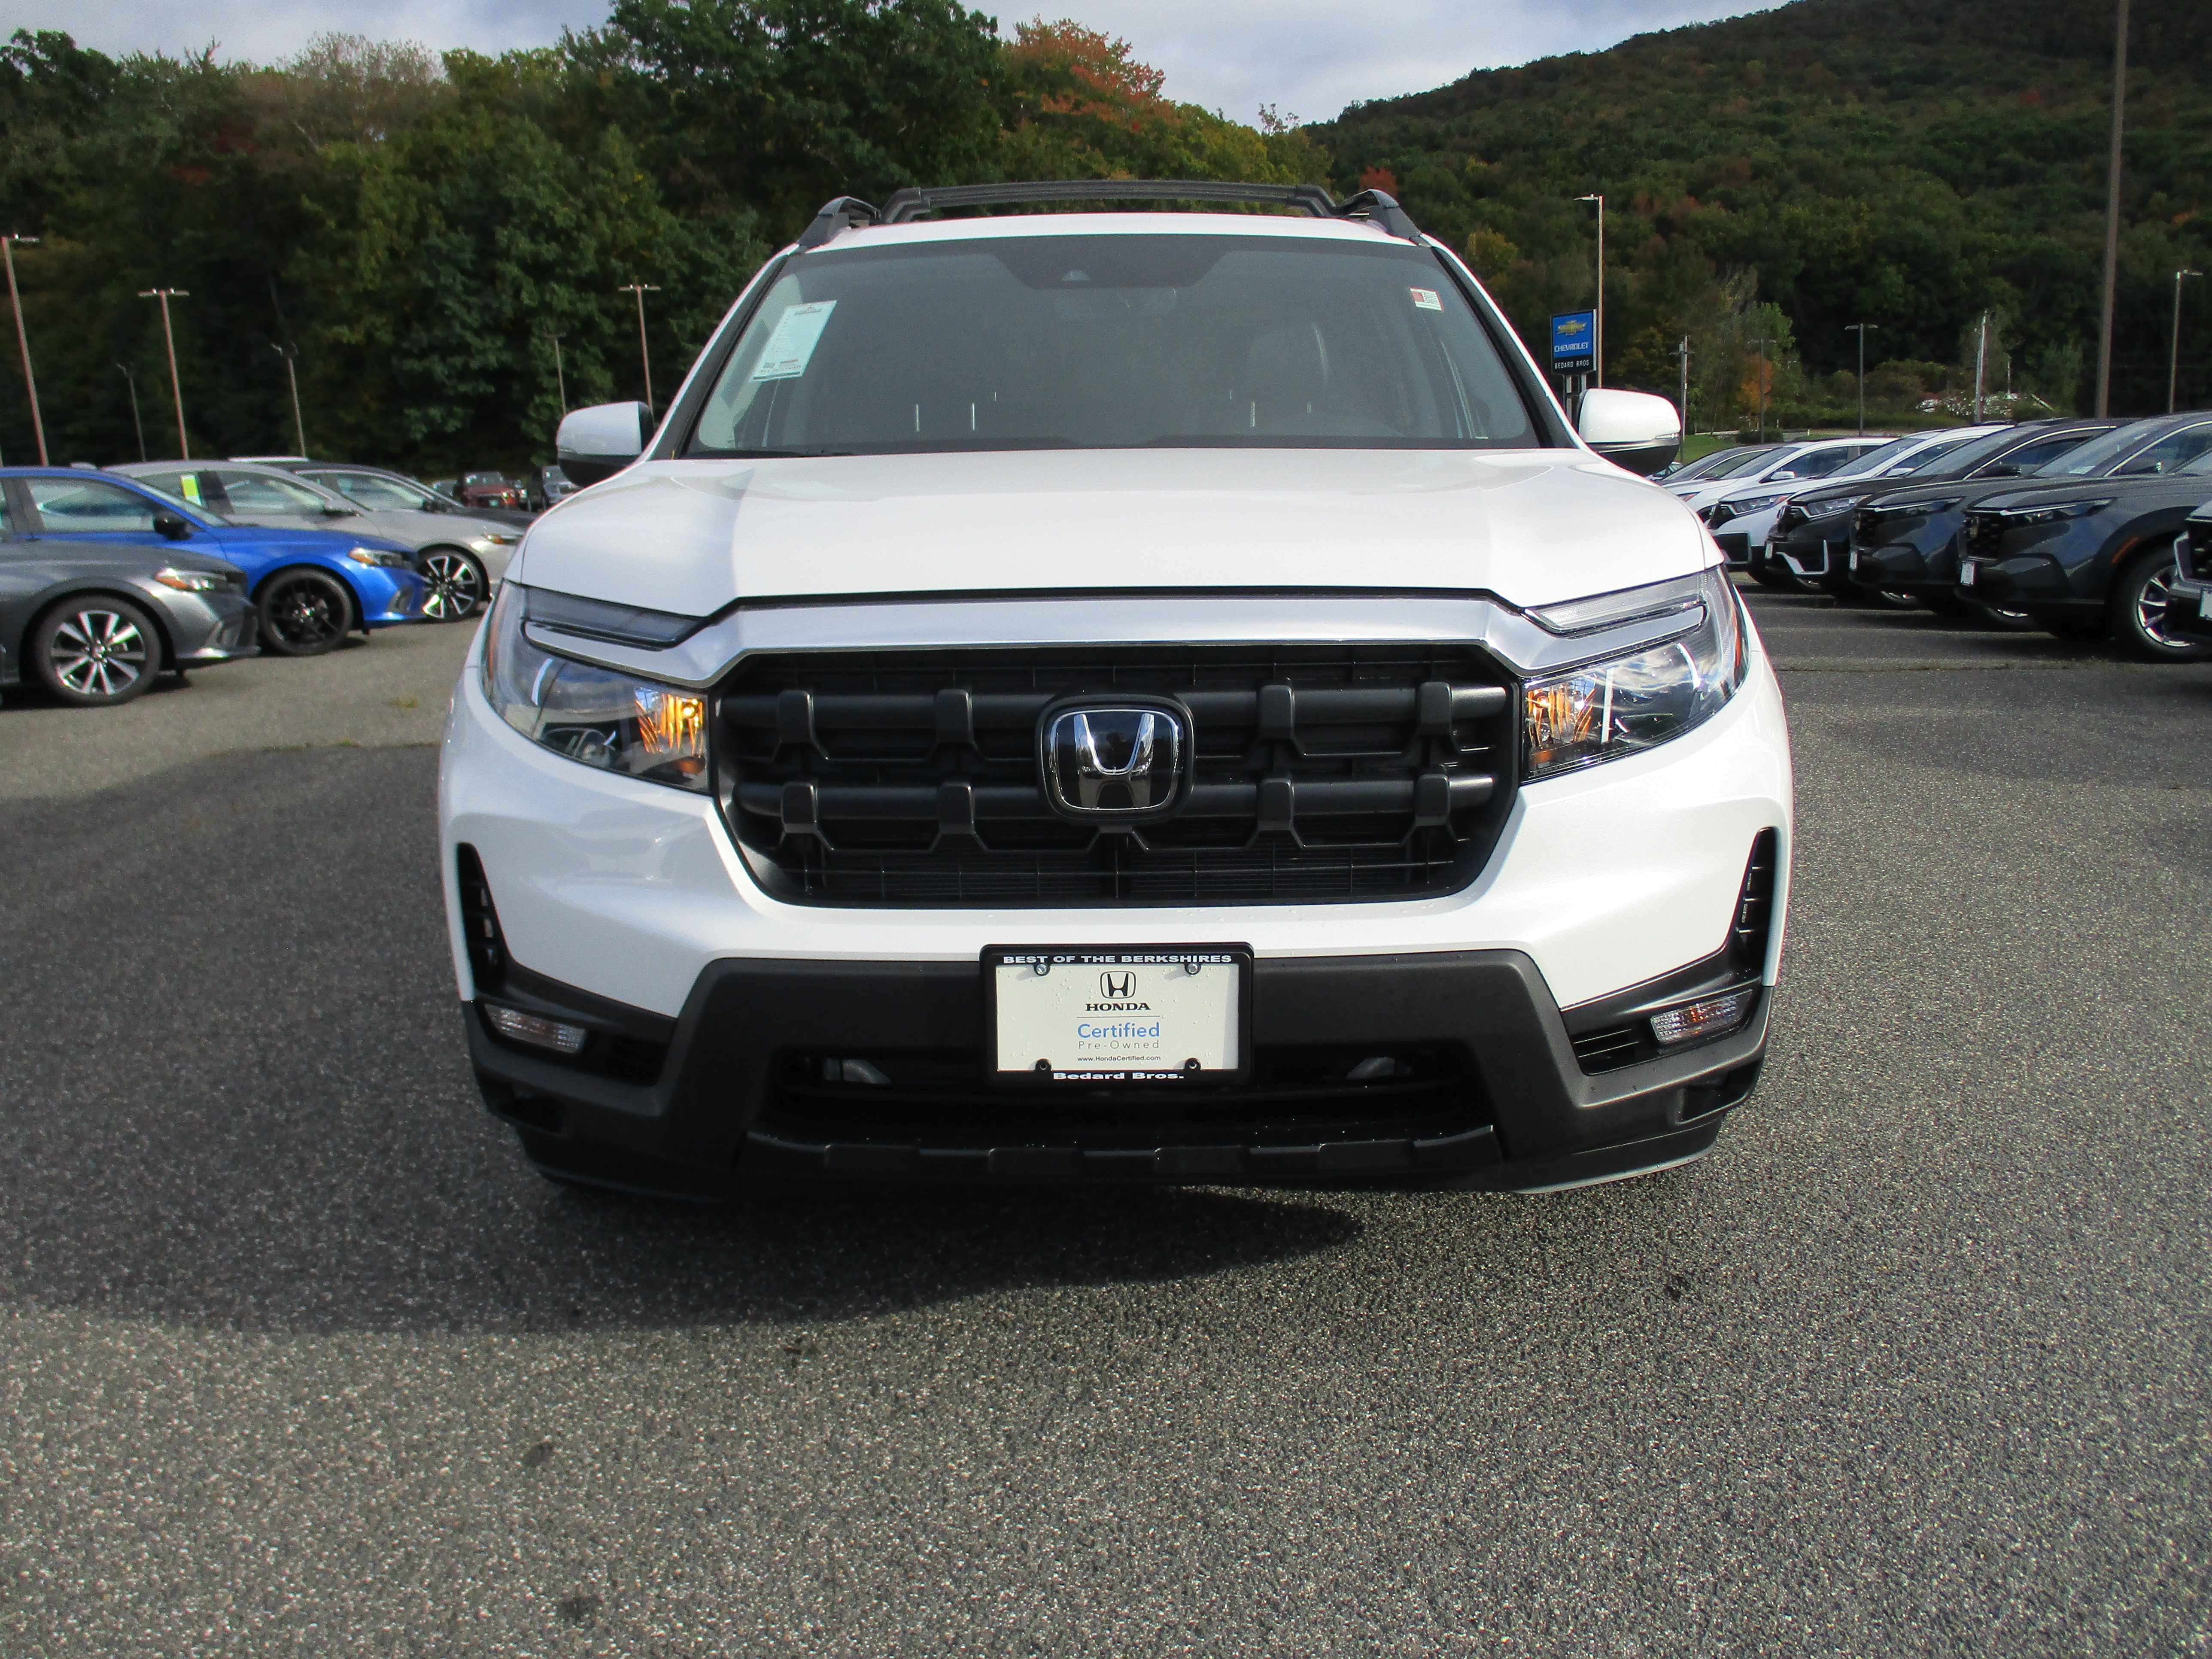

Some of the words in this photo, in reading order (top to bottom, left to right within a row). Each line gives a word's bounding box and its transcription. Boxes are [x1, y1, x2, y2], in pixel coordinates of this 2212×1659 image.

[1554, 342, 1589, 352] CHEVROLET
[1085, 1003, 1152, 1011] HONDA
[1078, 1022, 1160, 1038] Certified
[1079, 1039, 1159, 1049] Pre-Owned
